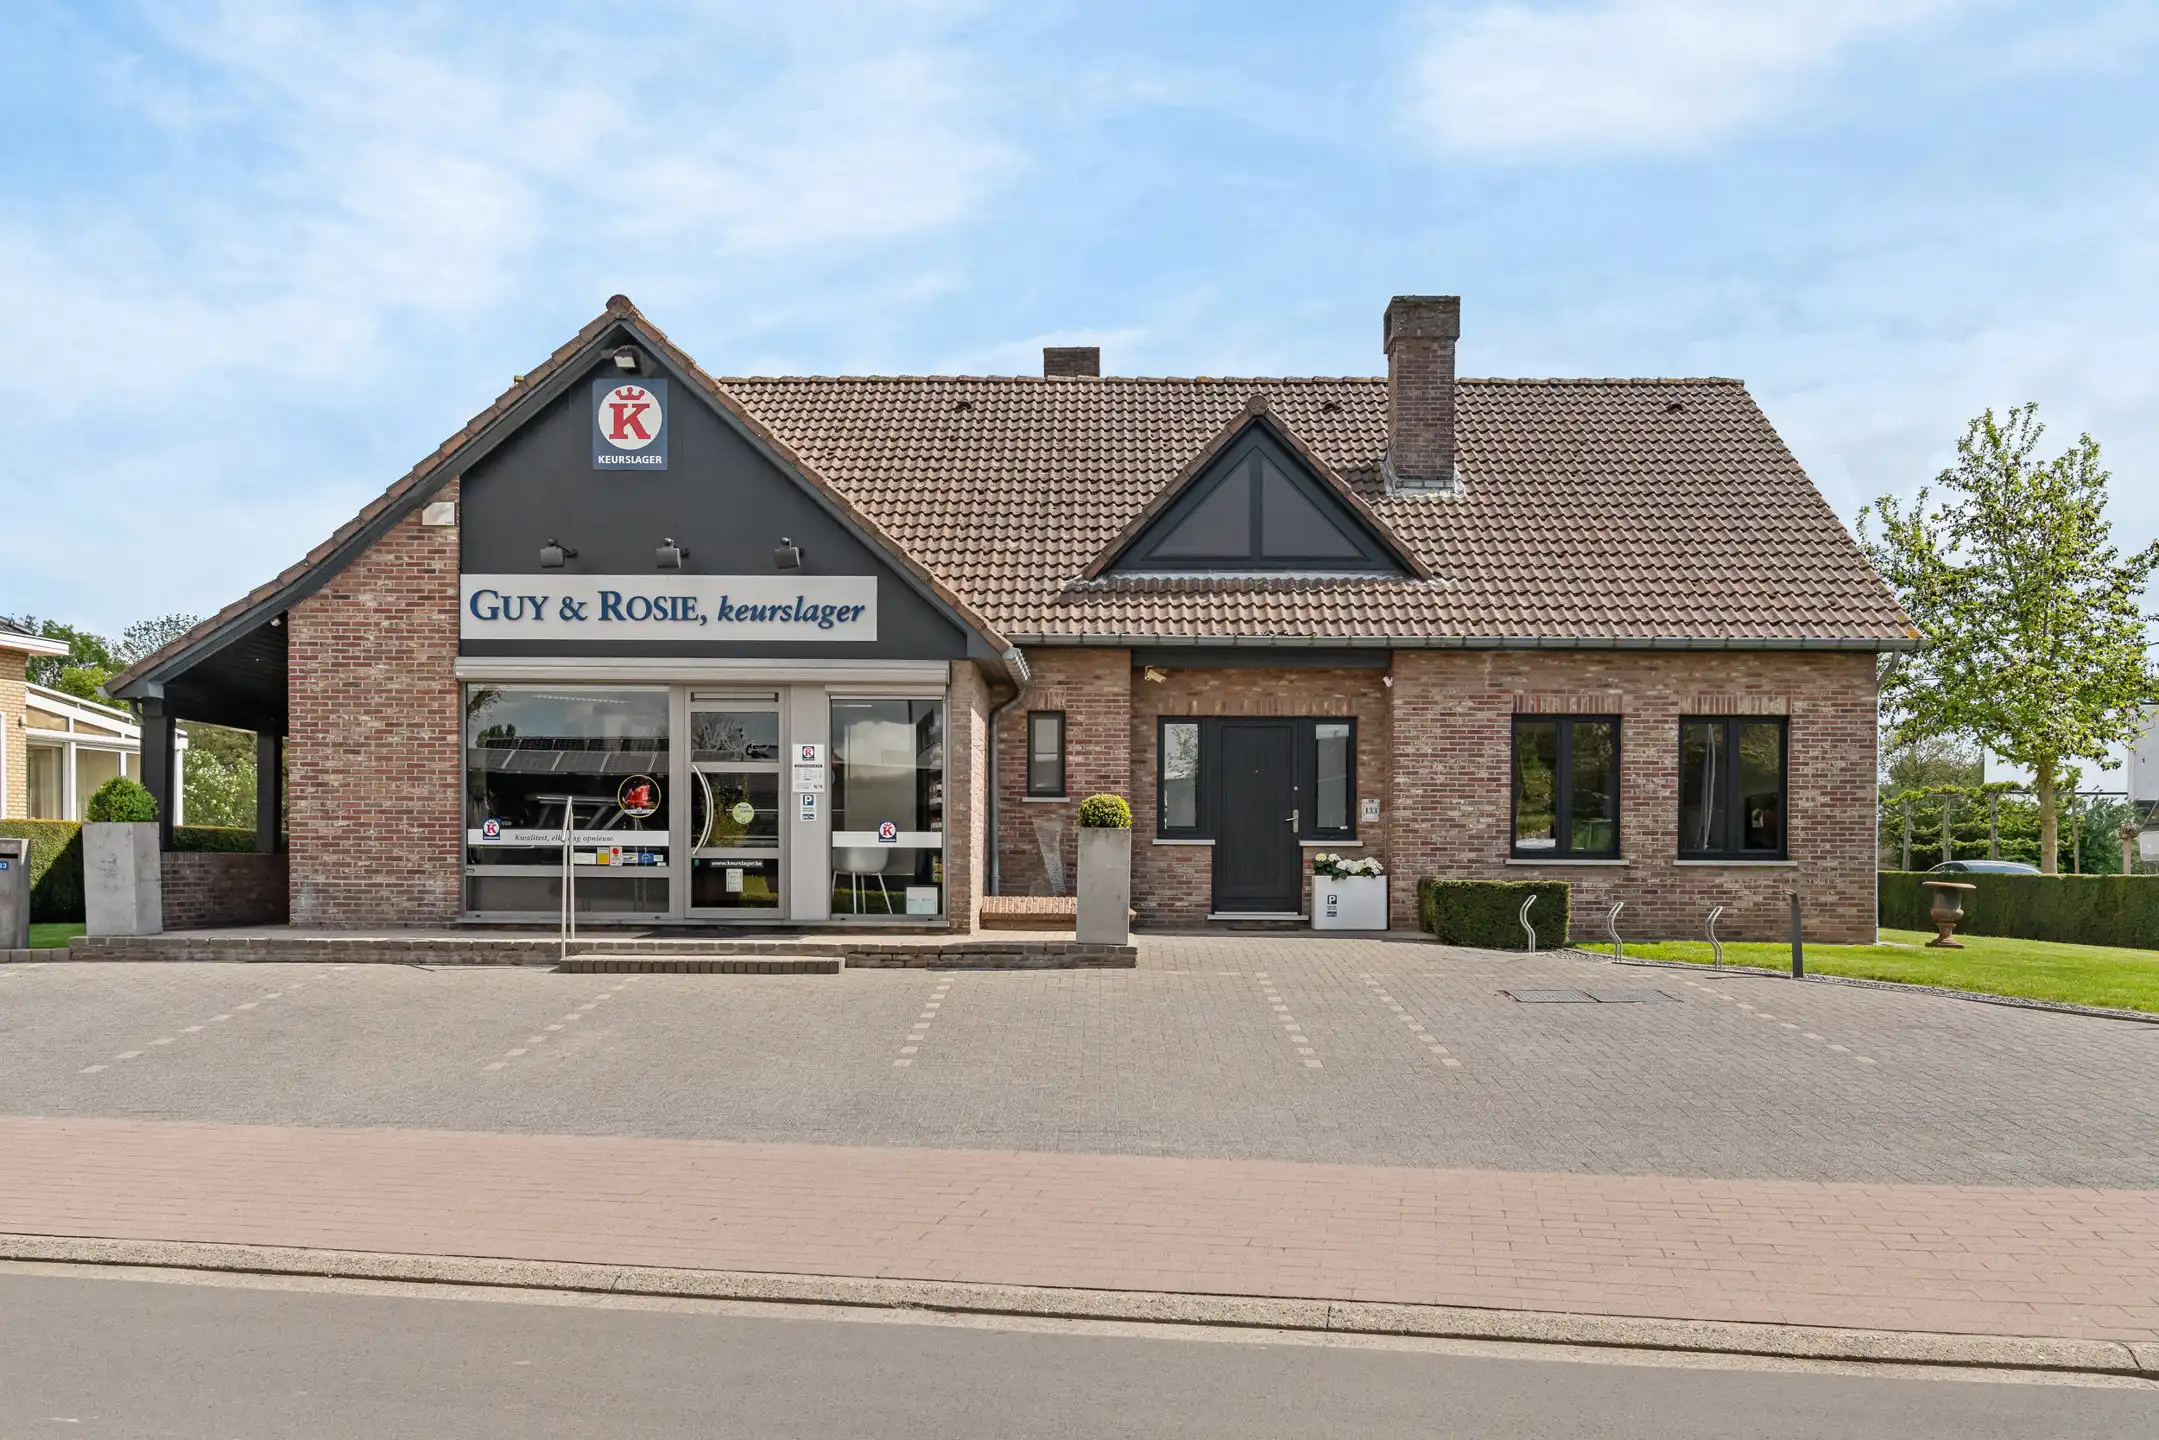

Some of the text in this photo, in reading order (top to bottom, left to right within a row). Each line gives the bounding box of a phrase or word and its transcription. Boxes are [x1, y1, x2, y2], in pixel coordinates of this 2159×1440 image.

[608, 403, 652, 440] K
[598, 455, 663, 464] KEURSLAGER
[469, 589, 865, 629] GUY & ROSIE, keurslager
[486, 824, 497, 834] K
[882, 826, 893, 836] K
